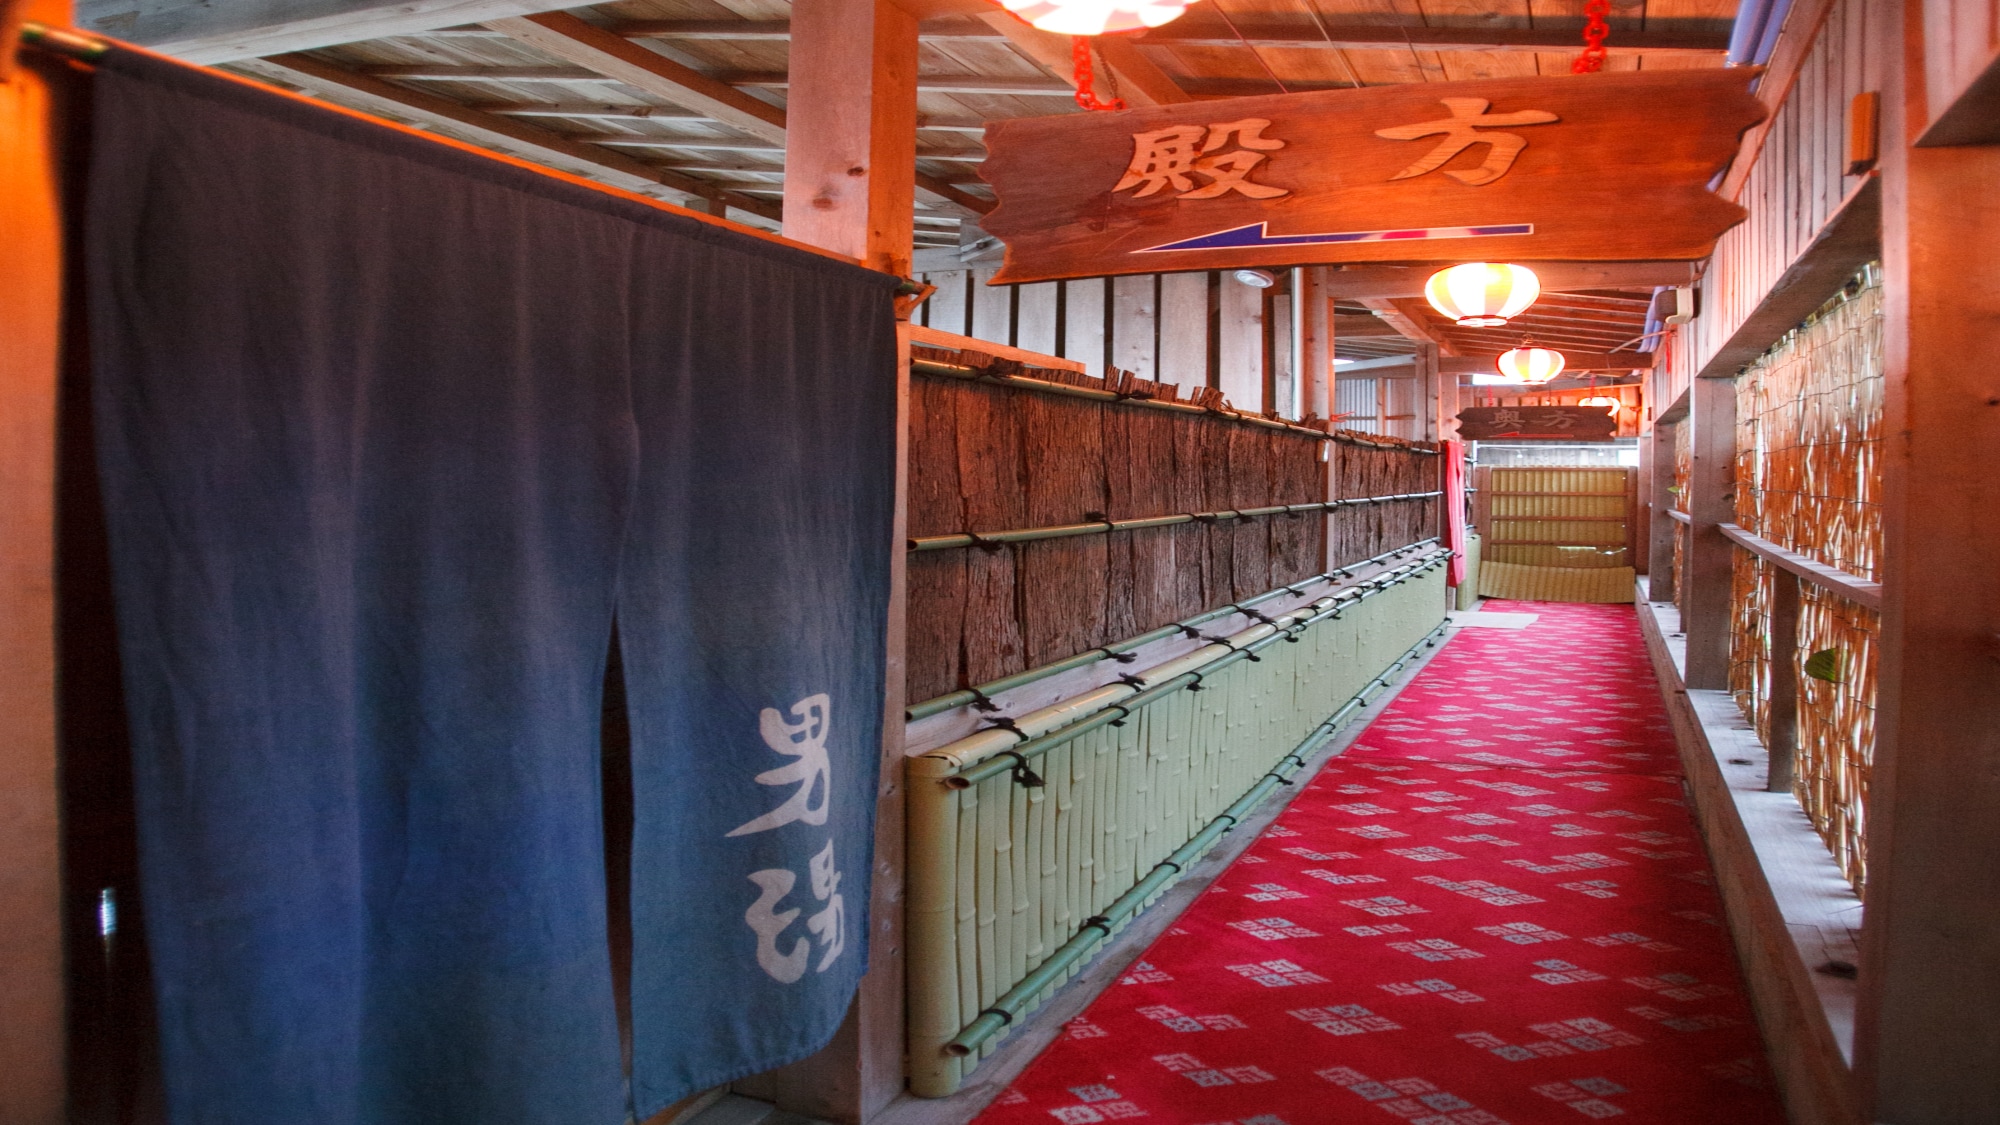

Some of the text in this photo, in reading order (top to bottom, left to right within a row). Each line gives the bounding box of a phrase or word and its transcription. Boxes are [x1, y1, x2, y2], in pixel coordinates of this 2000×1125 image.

[1112, 97, 1559, 201] 殿方
[1488, 409, 1583, 429] 奥方
[724, 693, 845, 984] 男湯
